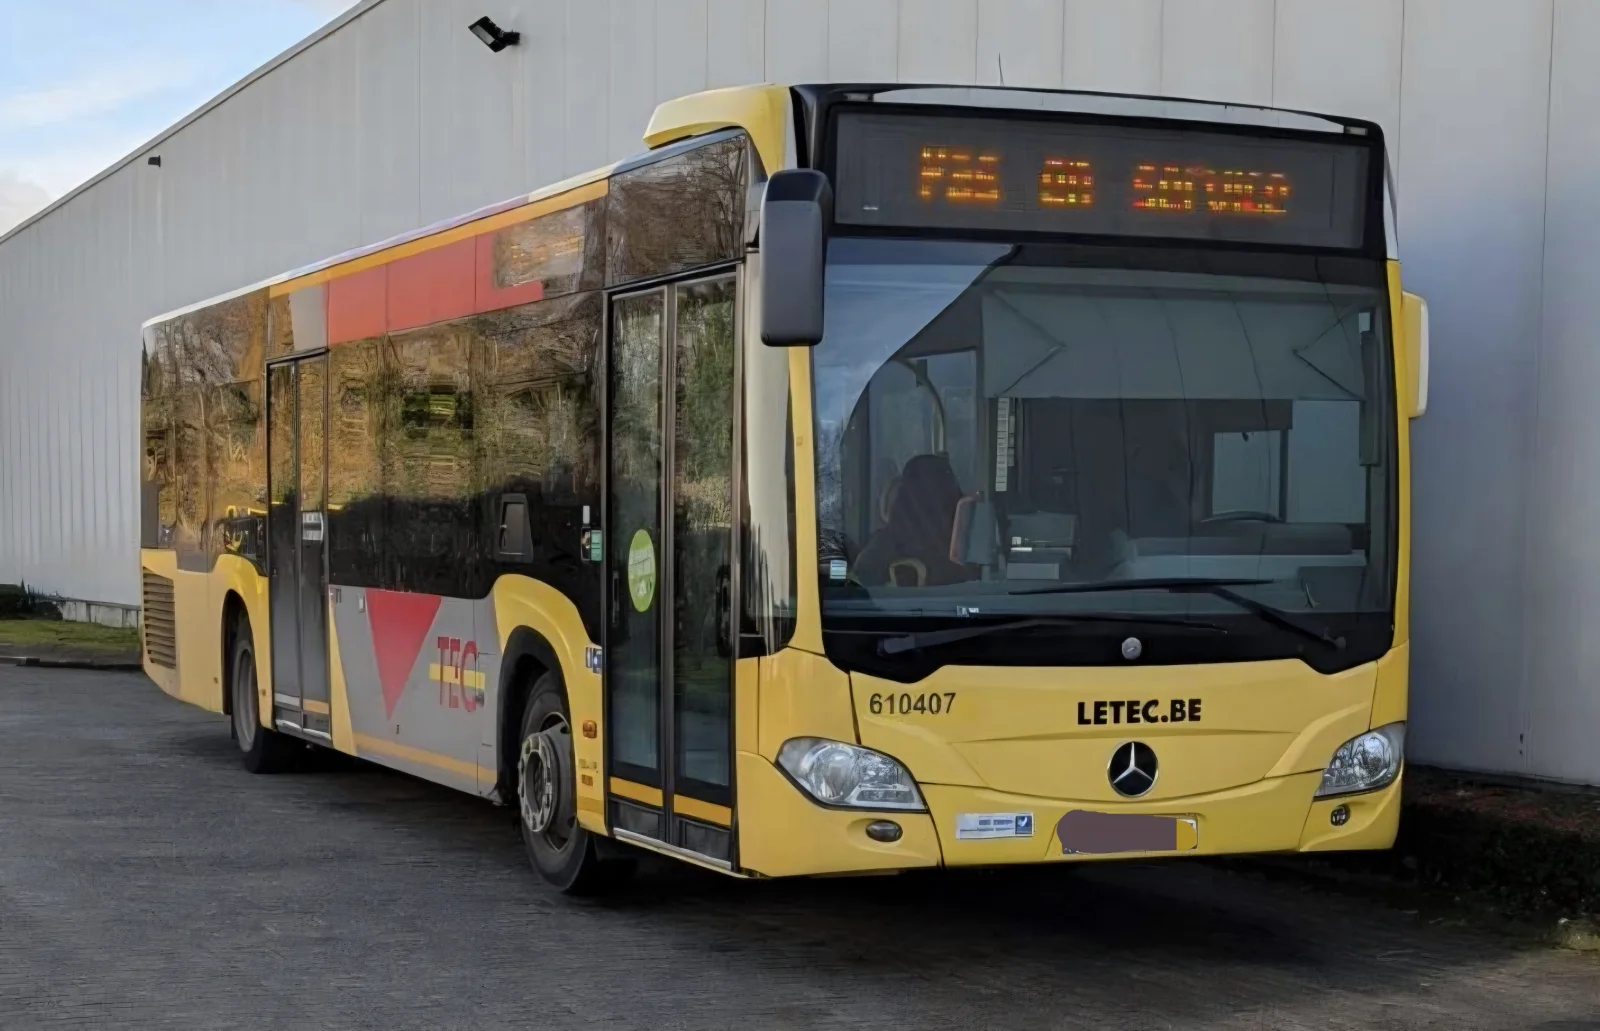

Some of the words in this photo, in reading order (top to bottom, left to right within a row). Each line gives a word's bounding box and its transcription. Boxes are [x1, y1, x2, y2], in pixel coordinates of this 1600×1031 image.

[437, 636, 479, 713] TEC
[868, 691, 957, 715] 610407
[1077, 698, 1203, 725] LETEC.BE
